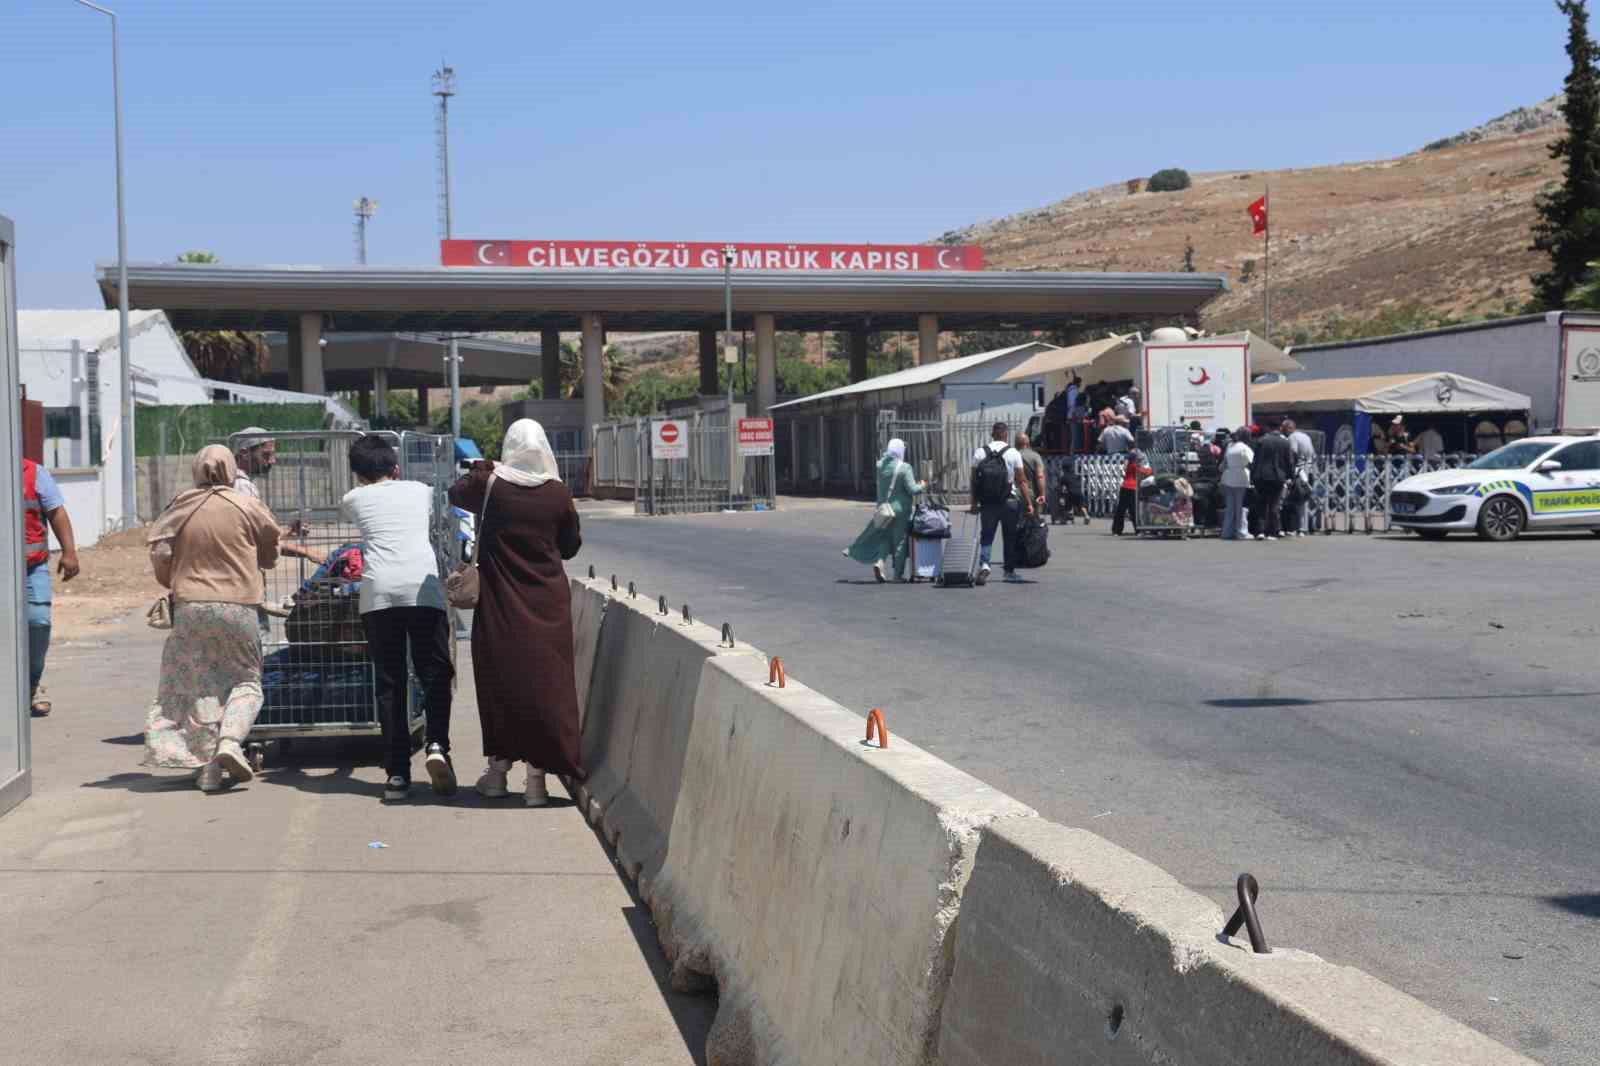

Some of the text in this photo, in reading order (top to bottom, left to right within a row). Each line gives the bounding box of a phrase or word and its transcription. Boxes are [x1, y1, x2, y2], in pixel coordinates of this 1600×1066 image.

[527, 242, 919, 271] CİLVEGÖZÜ GÜMRÜK KAPISI
[1538, 495, 1571, 507] TRAFİK
